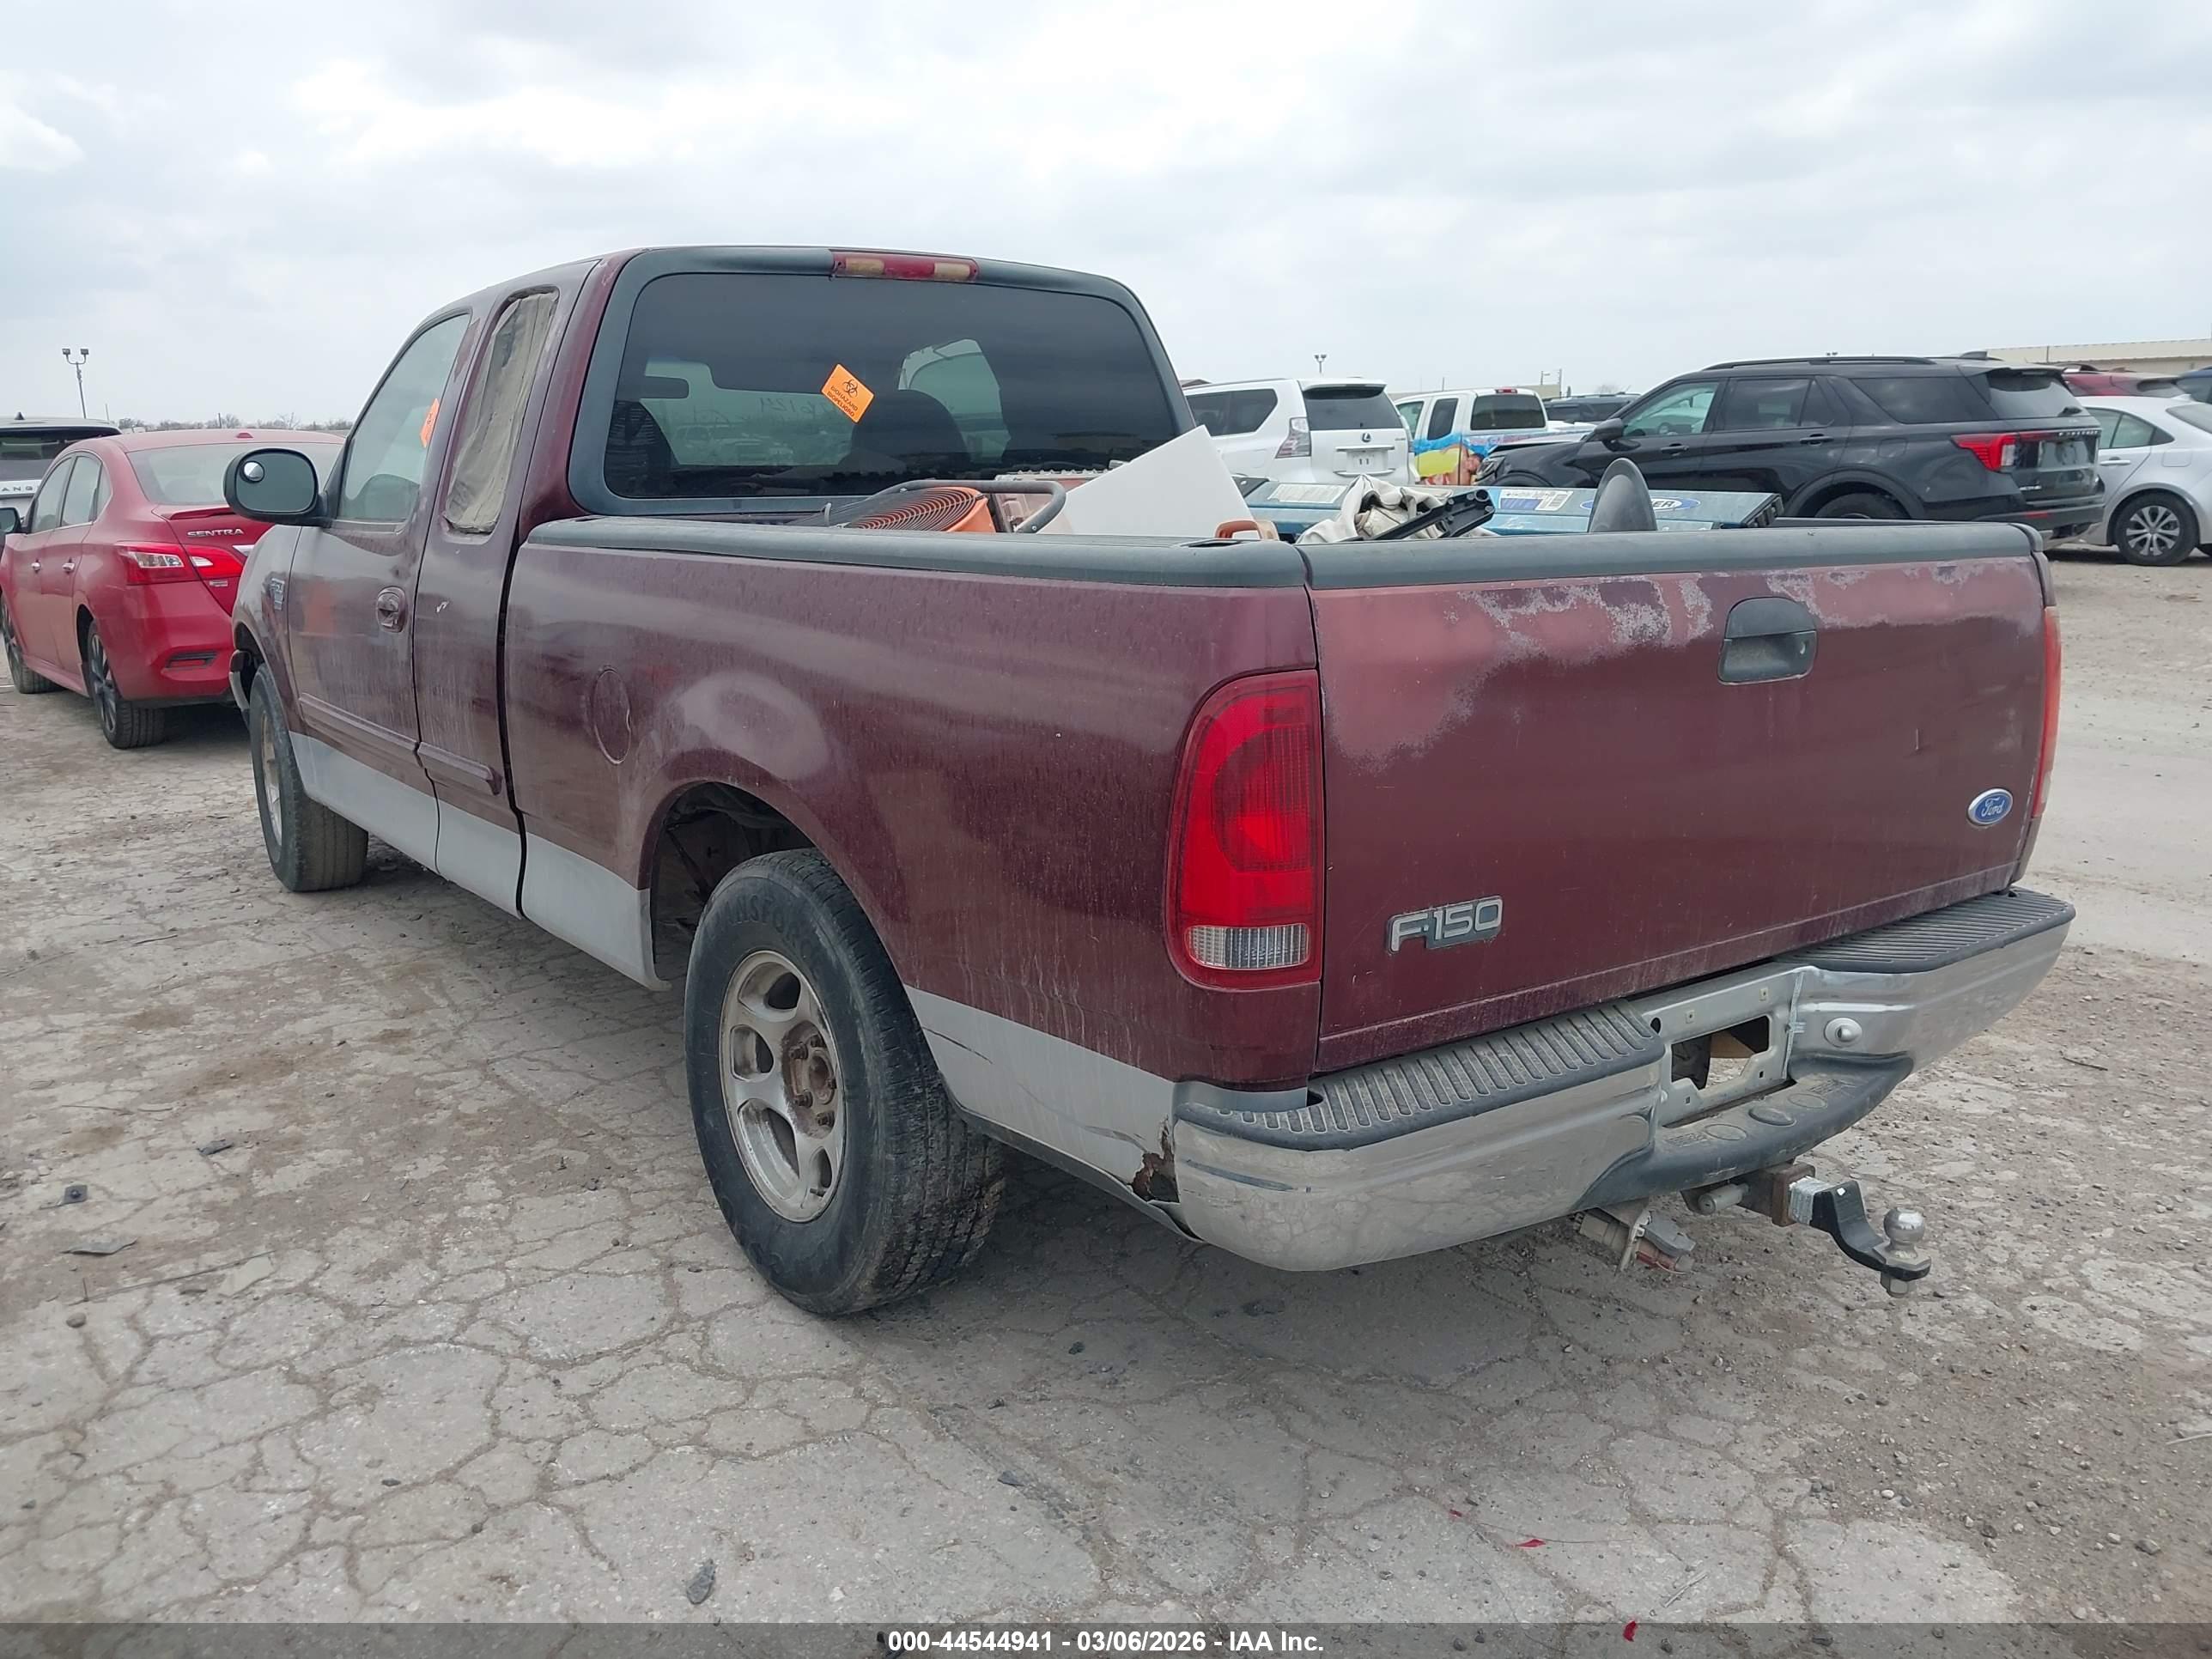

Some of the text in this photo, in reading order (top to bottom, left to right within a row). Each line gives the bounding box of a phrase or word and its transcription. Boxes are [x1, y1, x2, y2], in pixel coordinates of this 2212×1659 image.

[827, 391, 855, 417] BIOPELIGRO
[830, 386, 859, 411] BIOHAZARD
[187, 528, 245, 537] SENTRA
